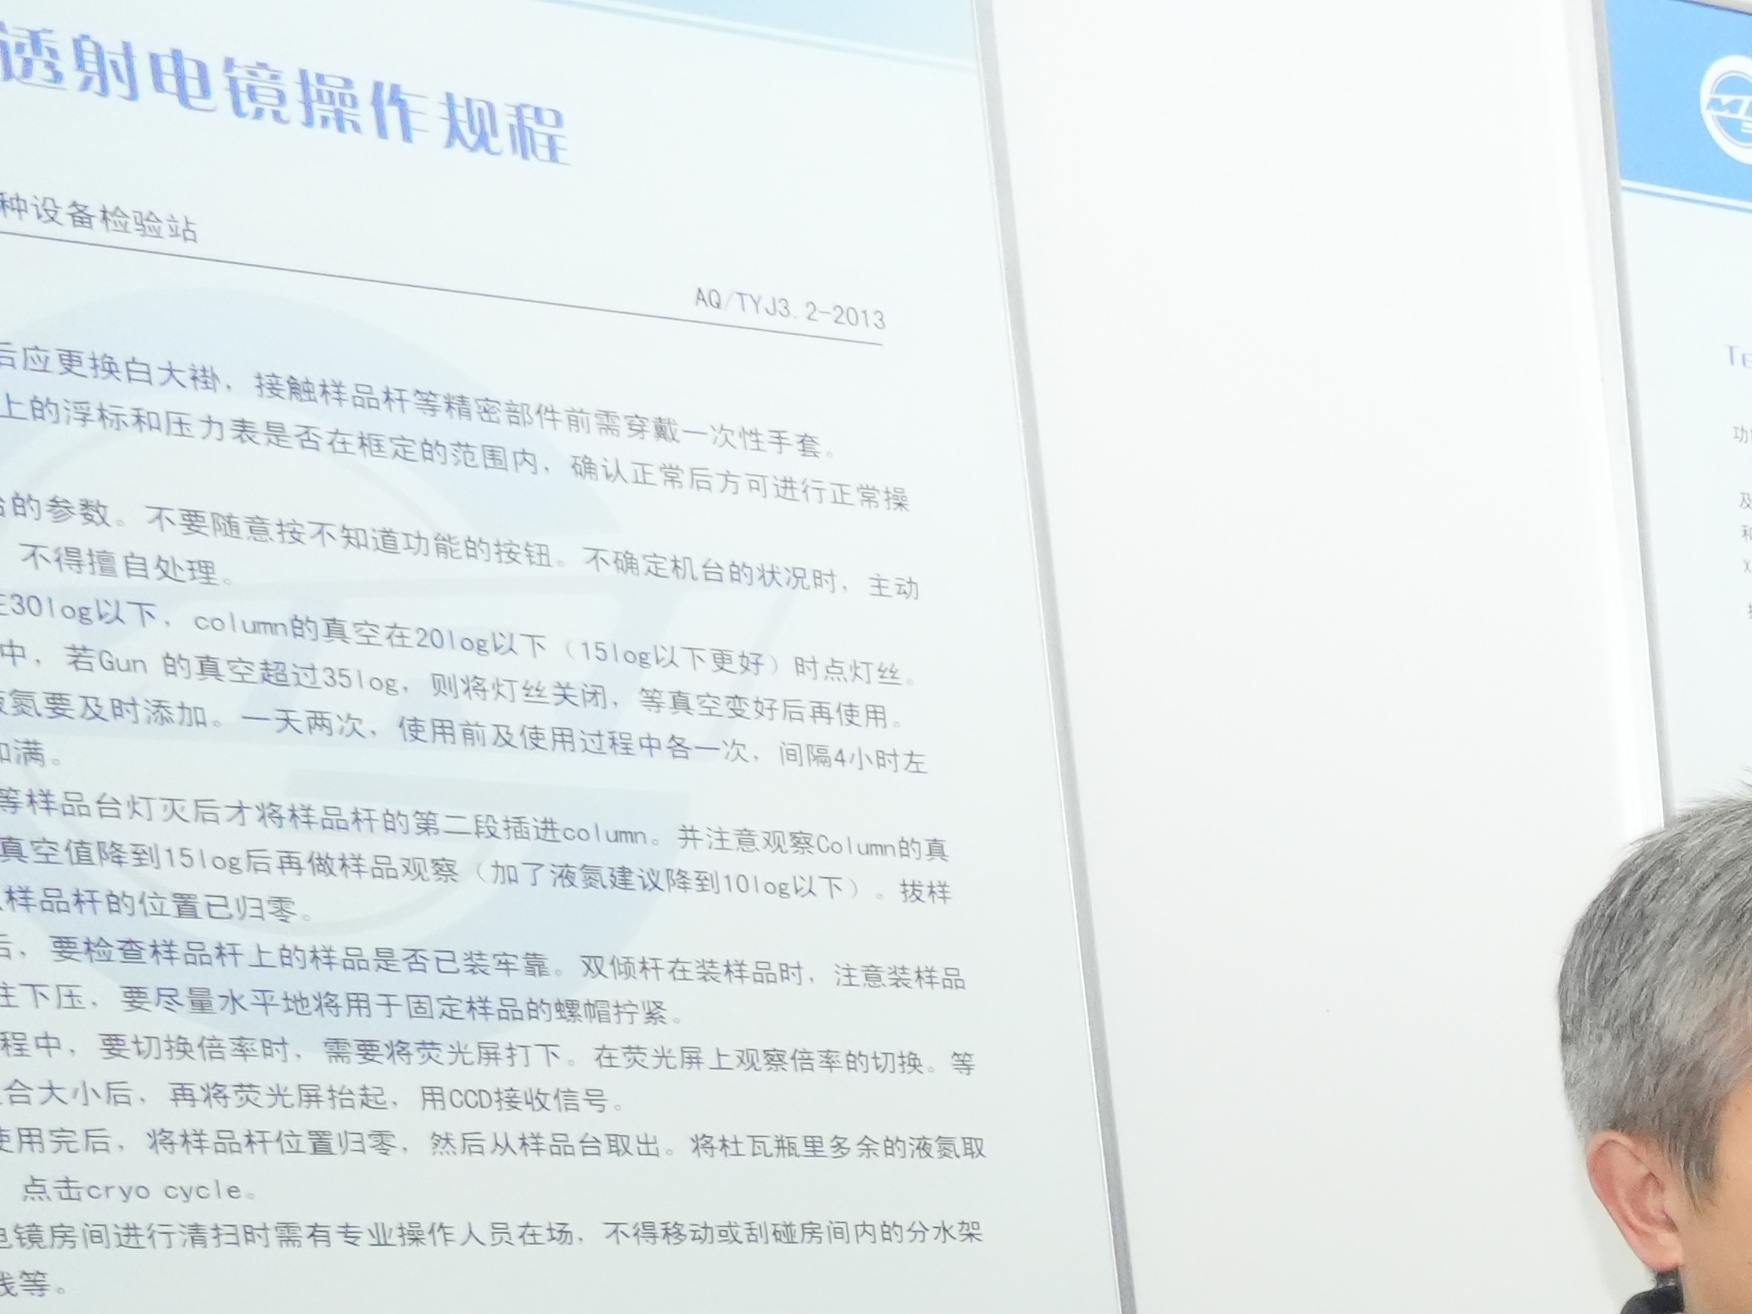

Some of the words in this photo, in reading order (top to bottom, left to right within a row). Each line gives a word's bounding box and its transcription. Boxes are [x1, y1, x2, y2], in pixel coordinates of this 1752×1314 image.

[0, 20, 571, 166] 透射电镜操作规程
[0, 192, 198, 243] 种设备检验站
[0, 885, 312, 924] 样品杆的位置已归零。
